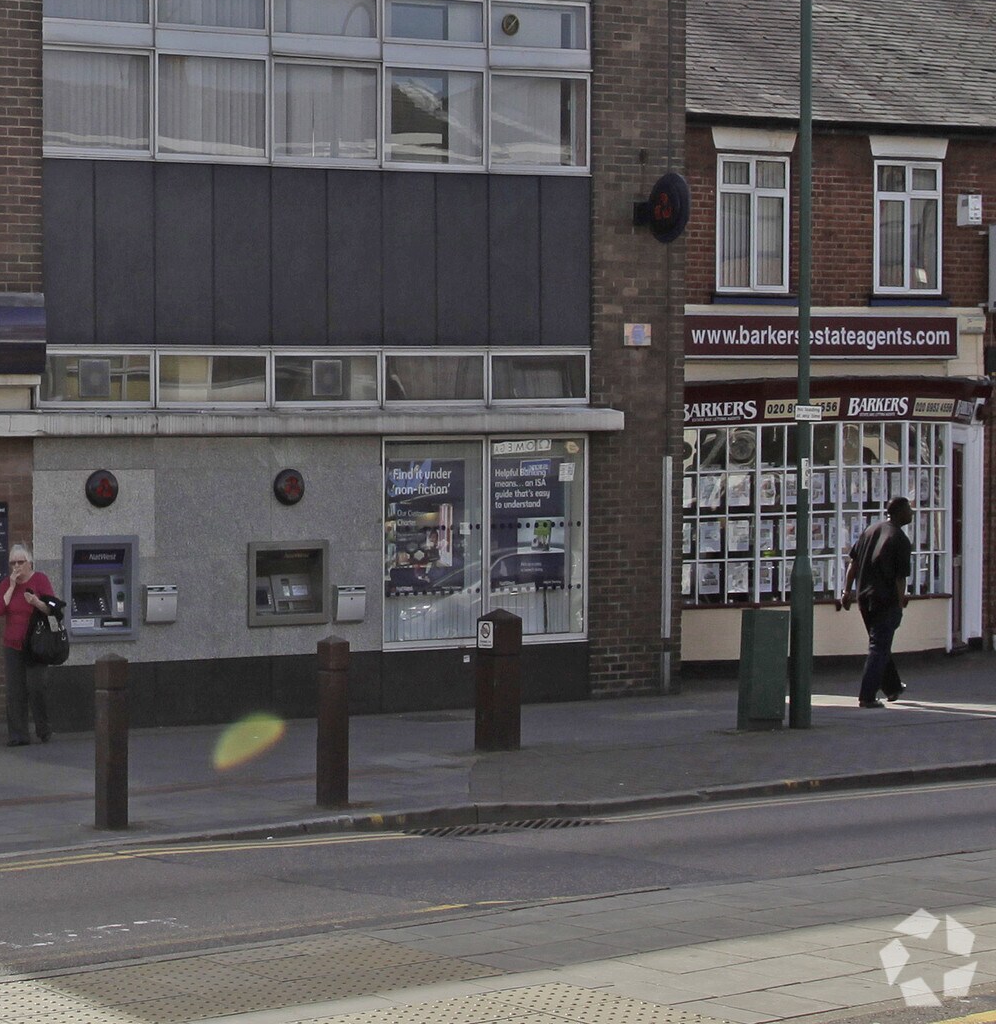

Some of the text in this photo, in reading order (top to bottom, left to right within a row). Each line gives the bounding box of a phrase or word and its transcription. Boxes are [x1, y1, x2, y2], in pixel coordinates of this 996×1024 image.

[767, 404, 785, 414] 020
[847, 397, 909, 416] BARKERS
[393, 467, 414, 479] Find
[424, 467, 452, 479] under
[495, 468, 519, 479] Helpful
[535, 478, 547, 487] ISA
[495, 489, 551, 500] guide that's easy
[504, 499, 541, 508] understand
[88, 553, 117, 561] NatWest
